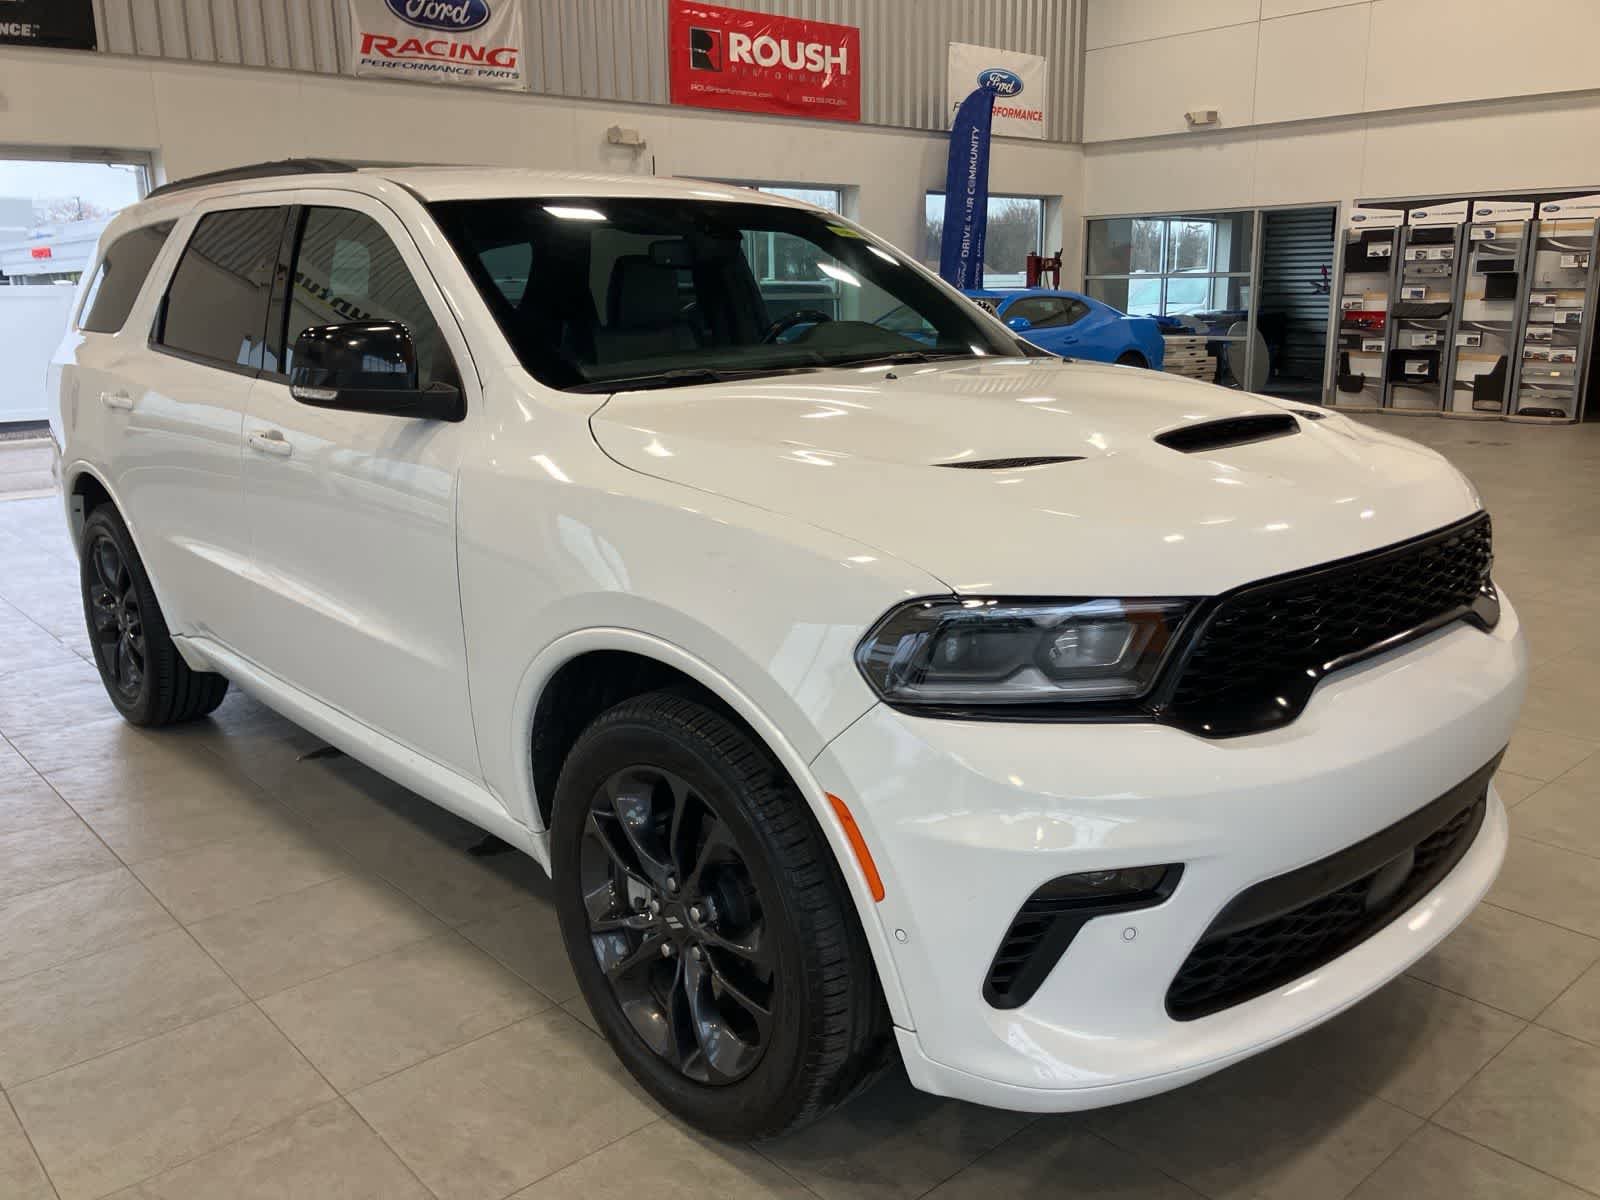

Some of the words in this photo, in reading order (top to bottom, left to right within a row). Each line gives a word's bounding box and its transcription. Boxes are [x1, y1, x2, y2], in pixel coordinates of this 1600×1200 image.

[360, 32, 519, 68] RACING
[728, 32, 848, 76] ROUSH
[360, 58, 474, 76] PERFORMANCE
[478, 69, 520, 80] PARTS
[992, 106, 1043, 122] RFORMANCE
[961, 224, 971, 258] DRIVE
